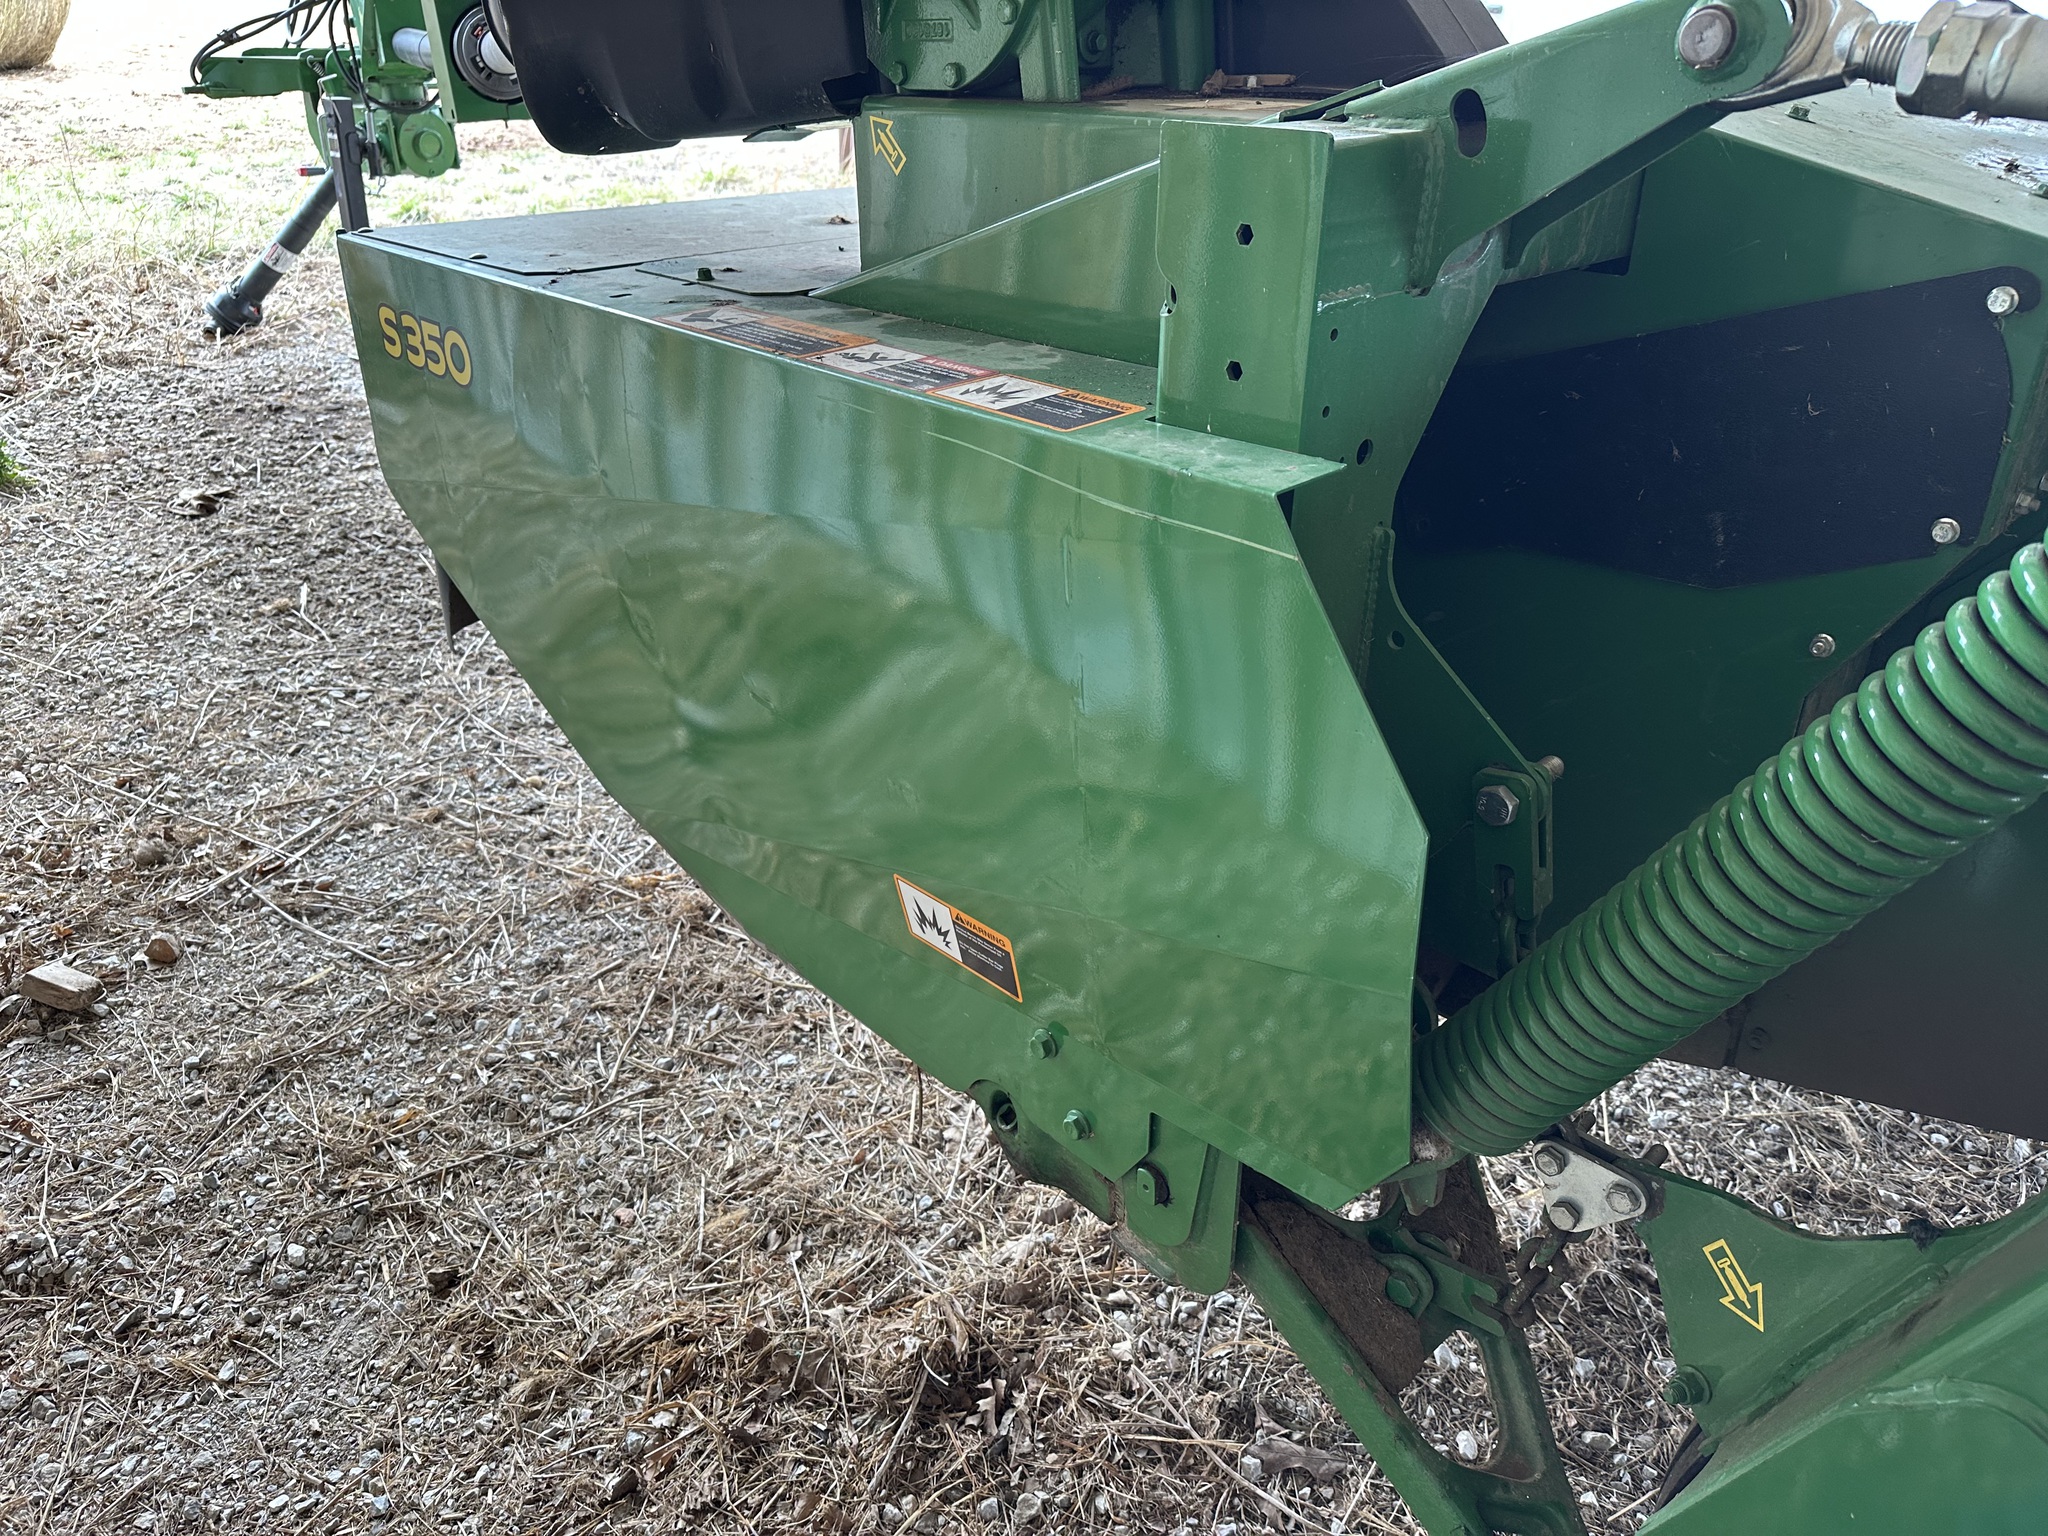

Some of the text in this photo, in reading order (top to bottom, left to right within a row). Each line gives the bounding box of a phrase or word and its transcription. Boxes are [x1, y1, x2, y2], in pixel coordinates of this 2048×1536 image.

[936, 359, 986, 376] DANGER
[1080, 394, 1132, 411] WARNING
[964, 919, 1006, 948] WARNING
